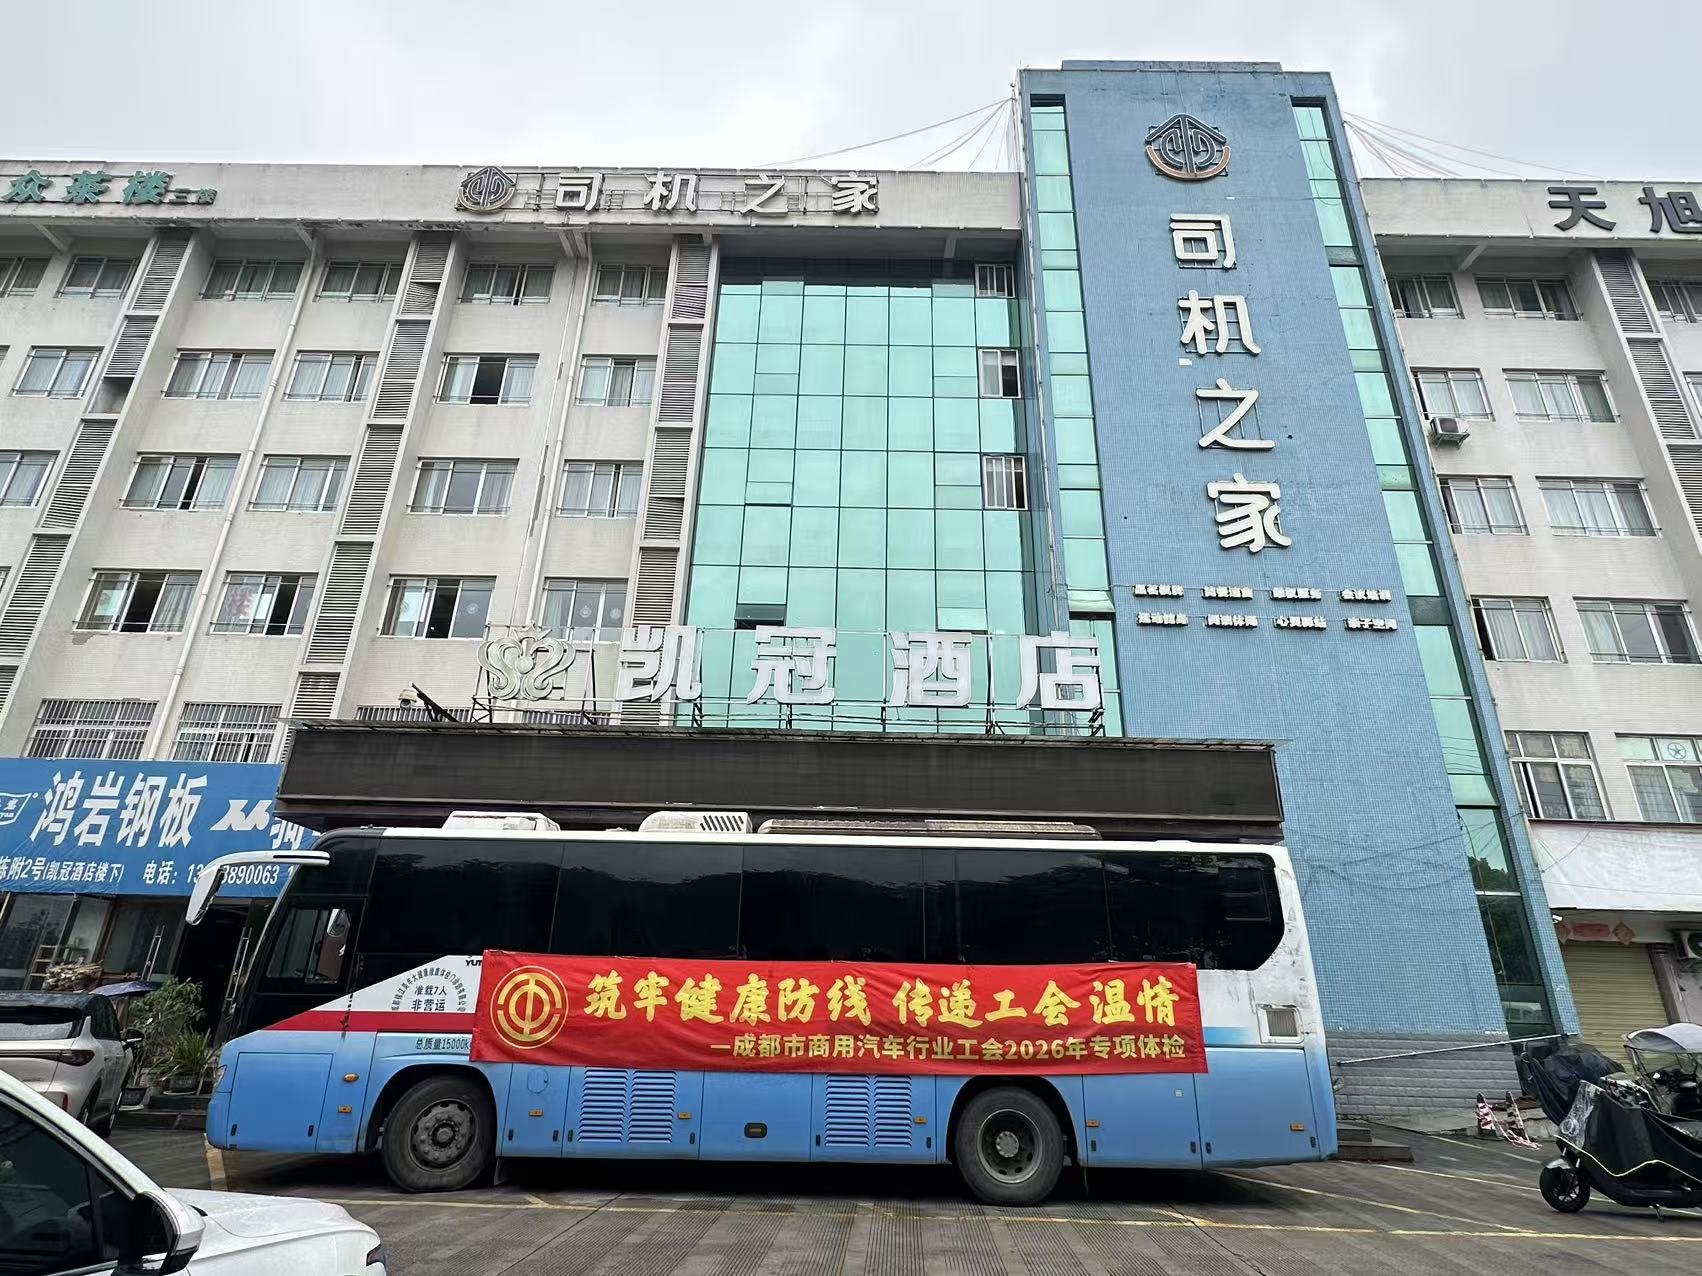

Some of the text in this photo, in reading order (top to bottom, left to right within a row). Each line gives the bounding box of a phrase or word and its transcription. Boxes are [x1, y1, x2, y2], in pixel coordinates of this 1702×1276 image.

[556, 171, 879, 214] 司机之家
[1548, 186, 1702, 234] 天旭
[1169, 212, 1293, 553] 司机之家
[614, 625, 1102, 712] 凯冠酒店
[30, 770, 208, 849] 鸿岩钢板
[411, 998, 446, 1012] 非营运
[414, 984, 448, 996] 准载7人
[583, 969, 1180, 1028] 筑牢健康防线 传递工会温情
[415, 1037, 472, 1051] 总质量15000k
